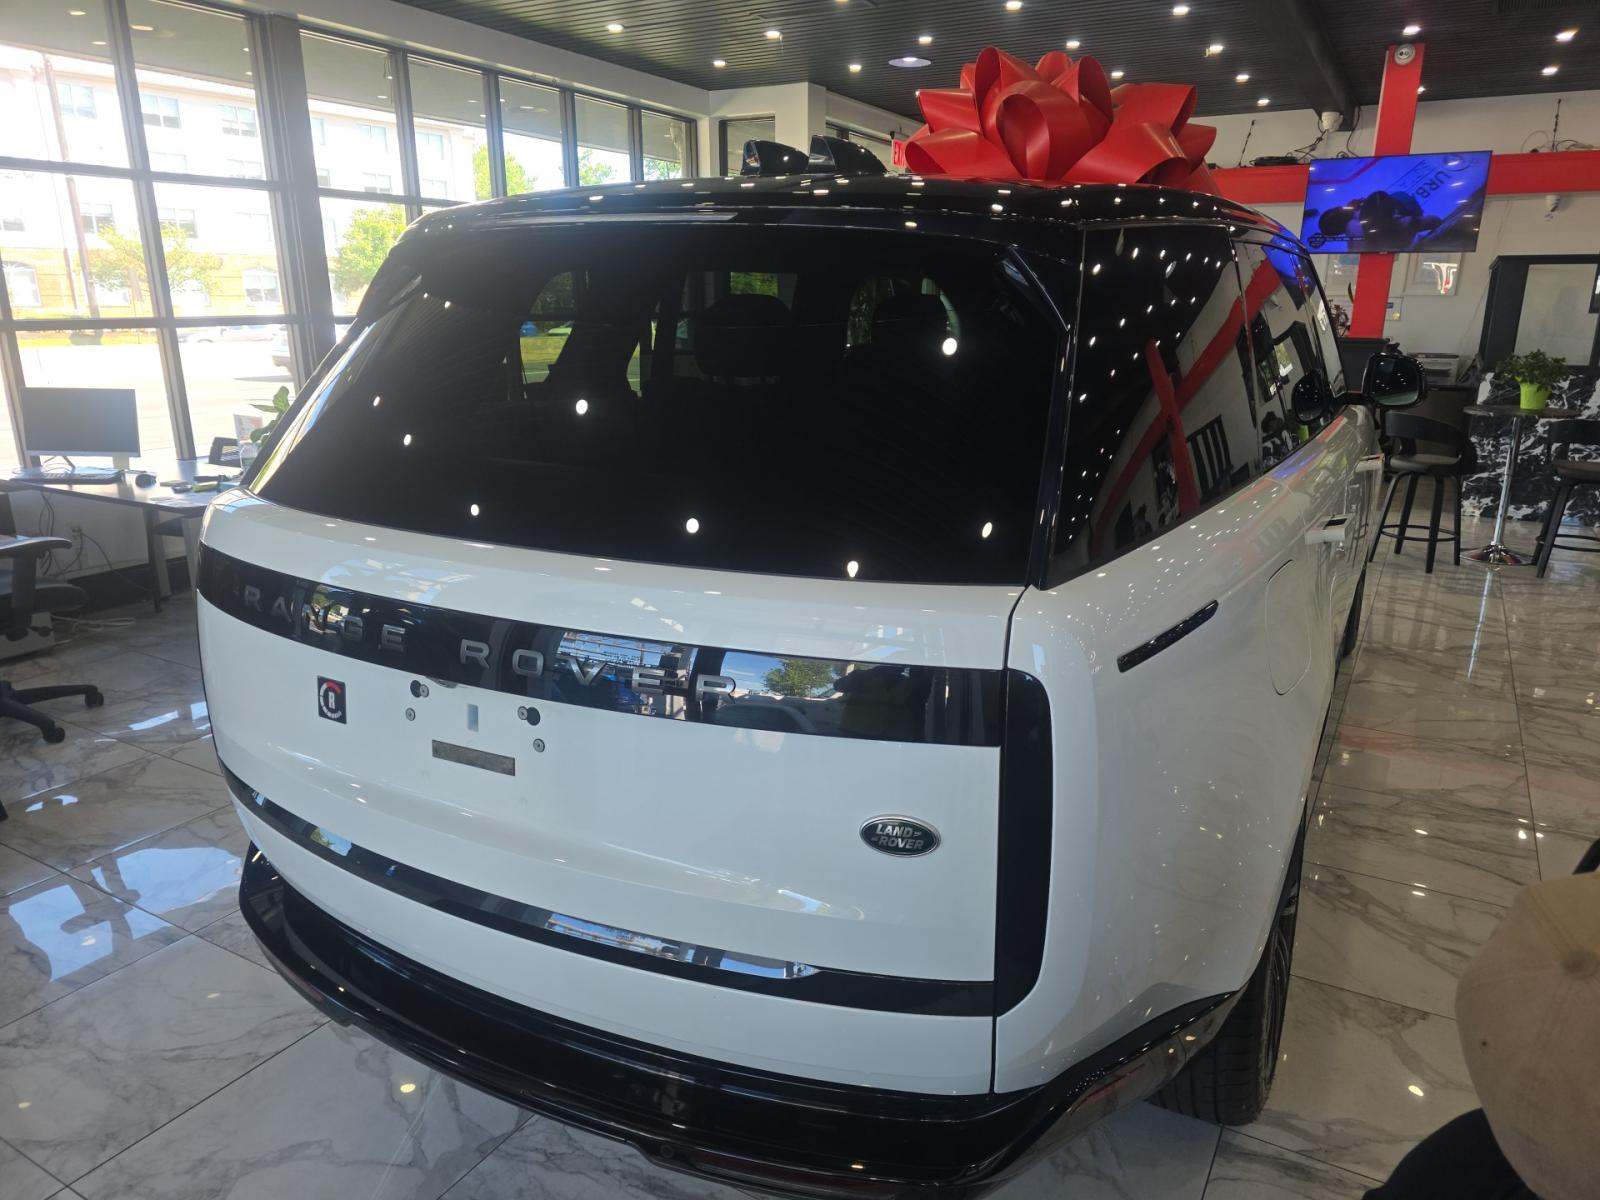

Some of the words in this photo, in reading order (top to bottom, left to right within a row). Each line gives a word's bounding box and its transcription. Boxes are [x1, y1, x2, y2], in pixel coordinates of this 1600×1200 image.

[244, 584, 407, 651] RANGE
[460, 638, 736, 703] ROVER
[875, 823, 914, 838] LAND
[878, 836, 924, 849] ROVER
